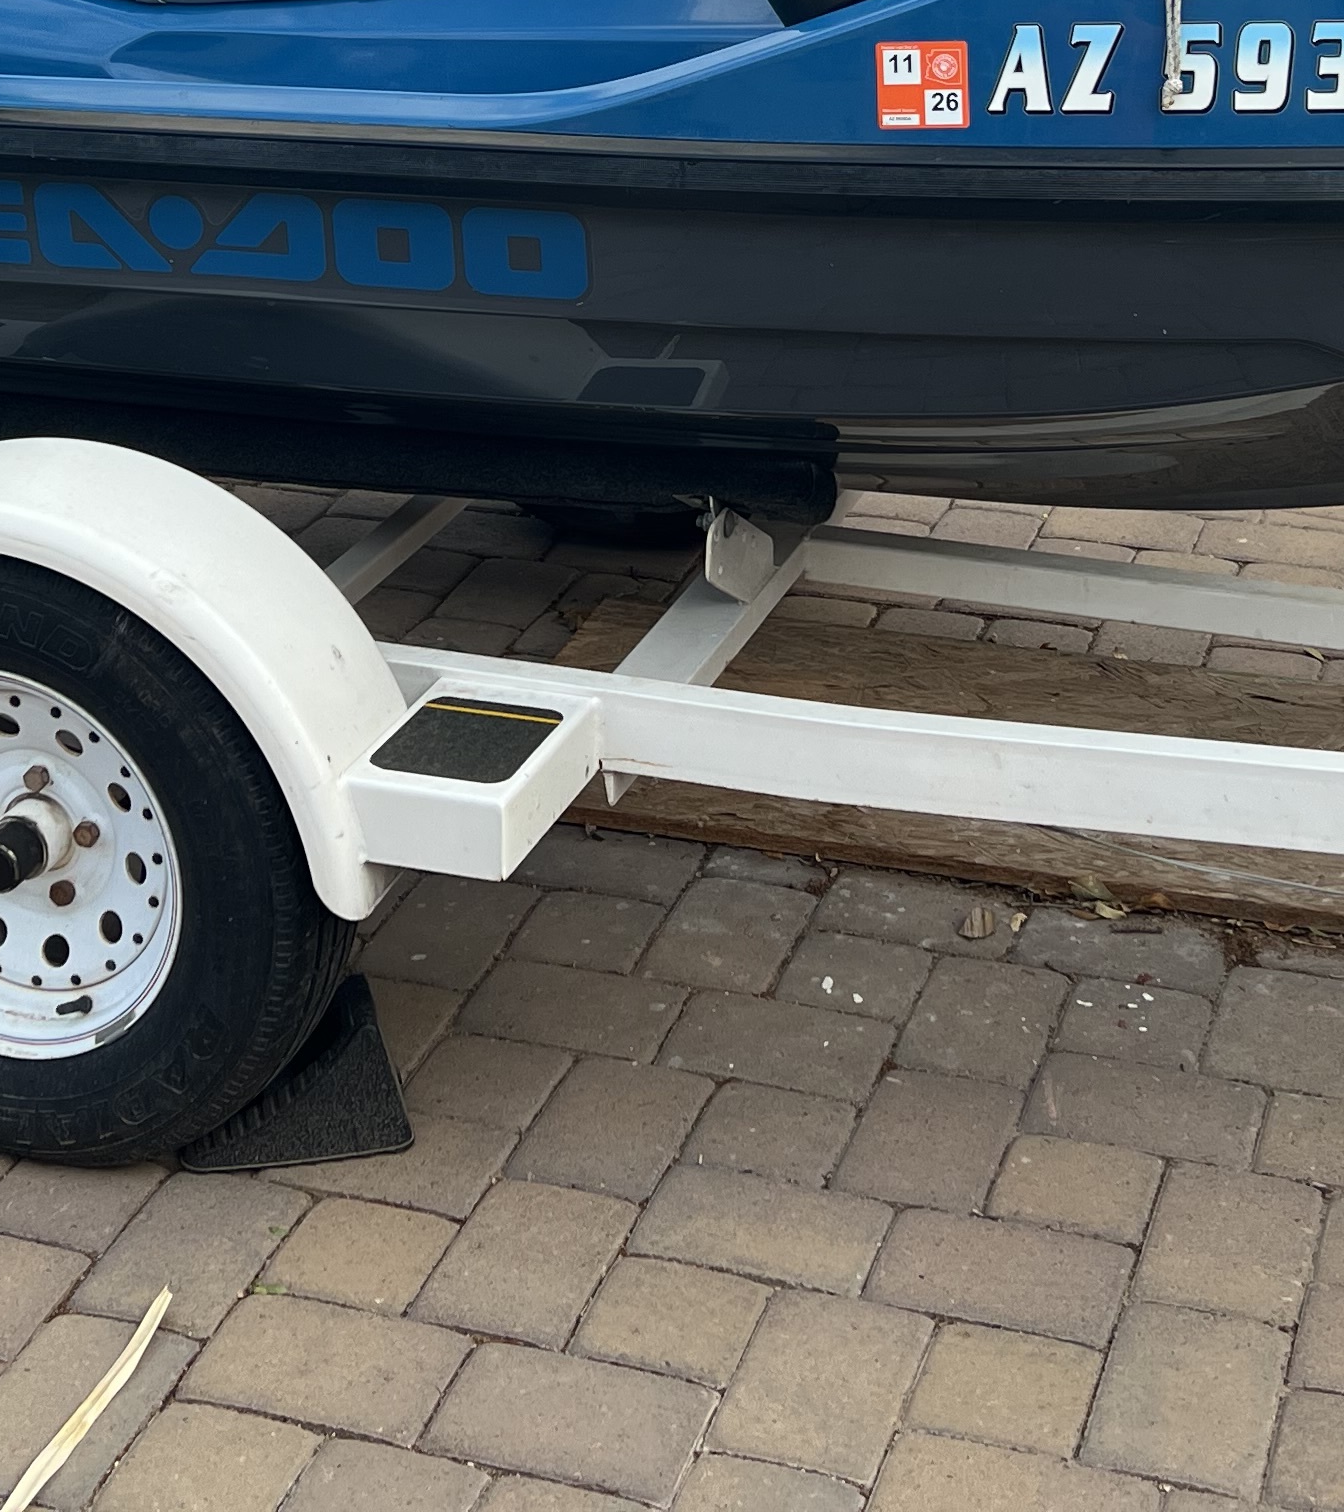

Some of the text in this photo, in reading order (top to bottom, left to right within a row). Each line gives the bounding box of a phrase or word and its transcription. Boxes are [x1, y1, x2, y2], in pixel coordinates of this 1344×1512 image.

[888, 53, 912, 74] 11
[985, 21, 1124, 115] AZ
[931, 91, 959, 112] 26
